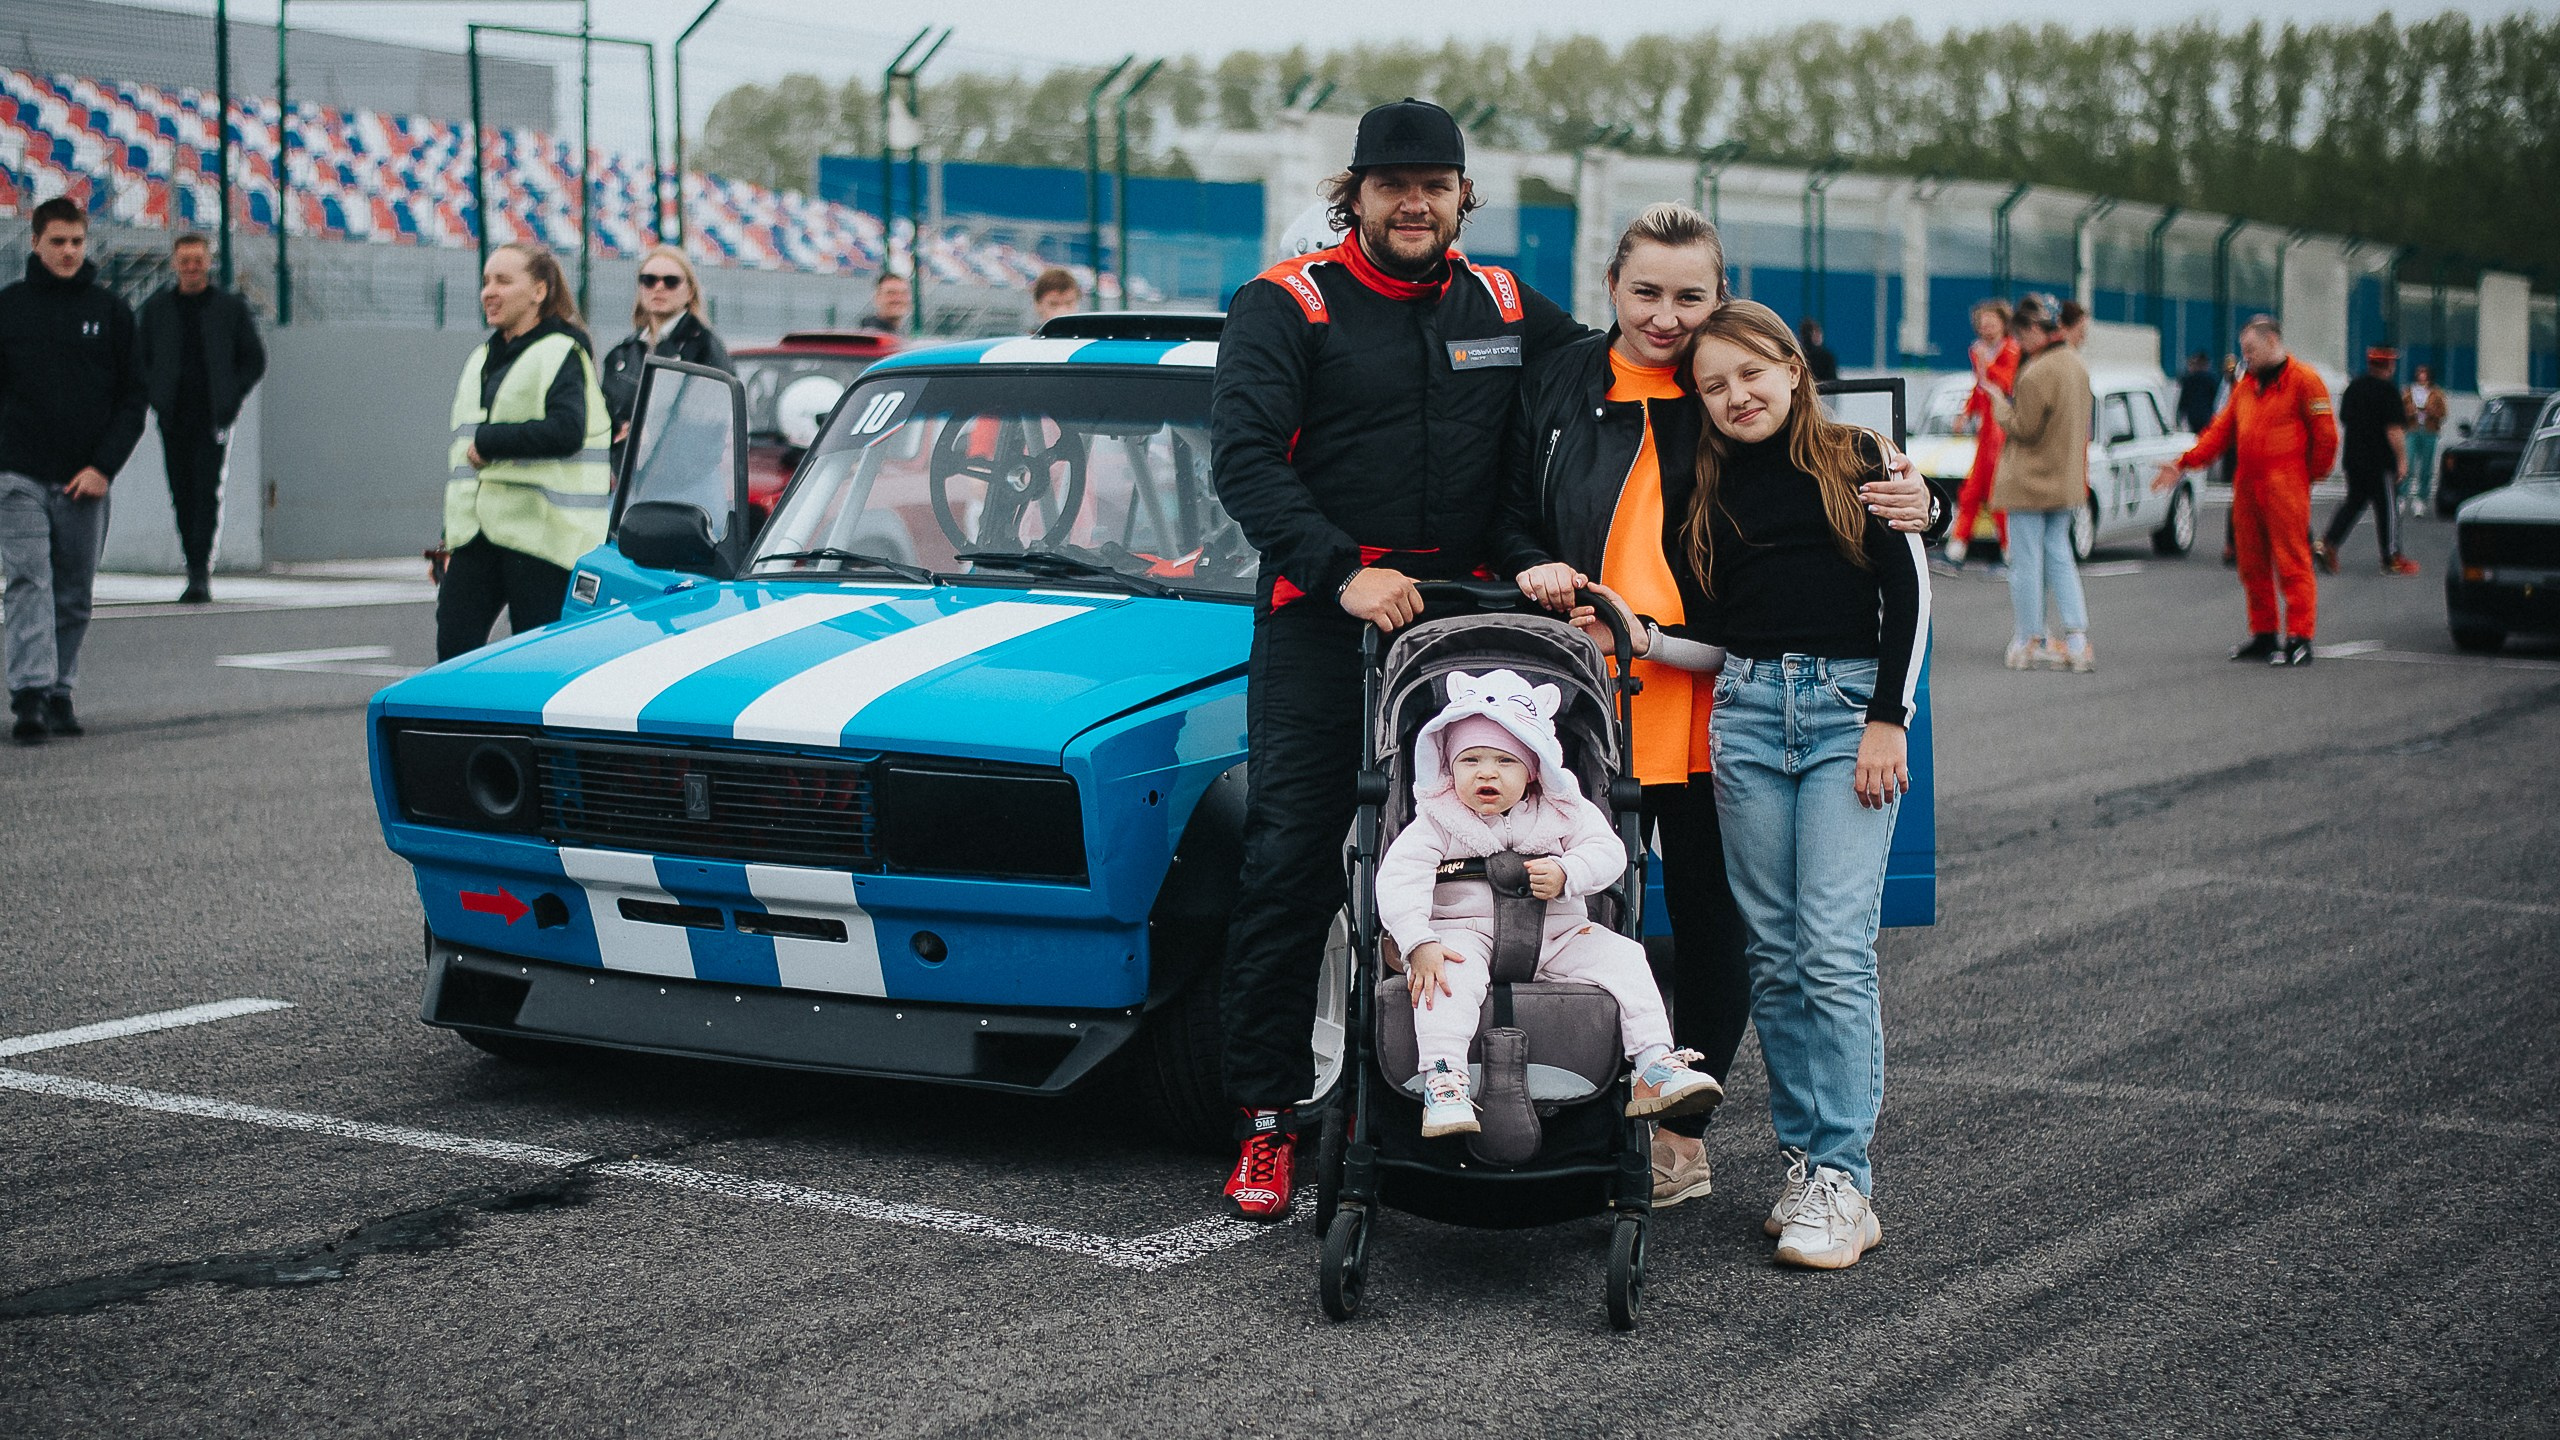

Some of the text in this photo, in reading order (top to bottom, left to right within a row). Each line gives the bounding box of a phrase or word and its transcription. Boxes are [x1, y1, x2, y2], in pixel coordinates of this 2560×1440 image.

[850, 390, 906, 436] 10
[1255, 1118, 1276, 1128] OMP
[1232, 1191, 1275, 1200] OMP
